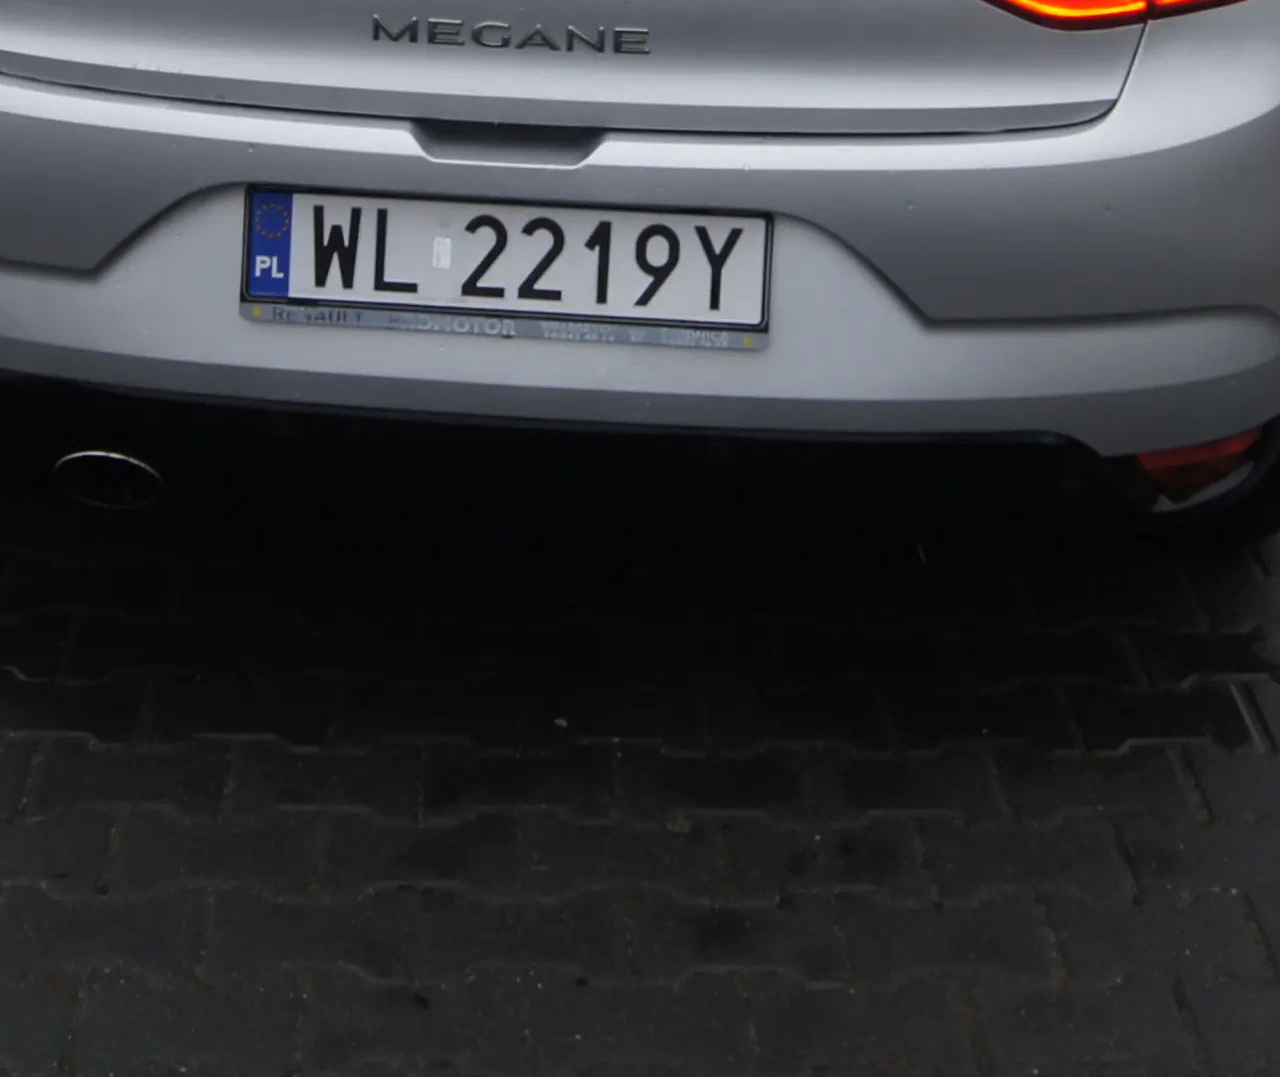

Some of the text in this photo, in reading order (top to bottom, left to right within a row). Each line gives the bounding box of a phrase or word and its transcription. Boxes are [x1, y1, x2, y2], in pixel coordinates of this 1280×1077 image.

[371, 13, 652, 55] MEGANE
[254, 255, 285, 280] PL
[312, 204, 745, 312] WL 2219Y
